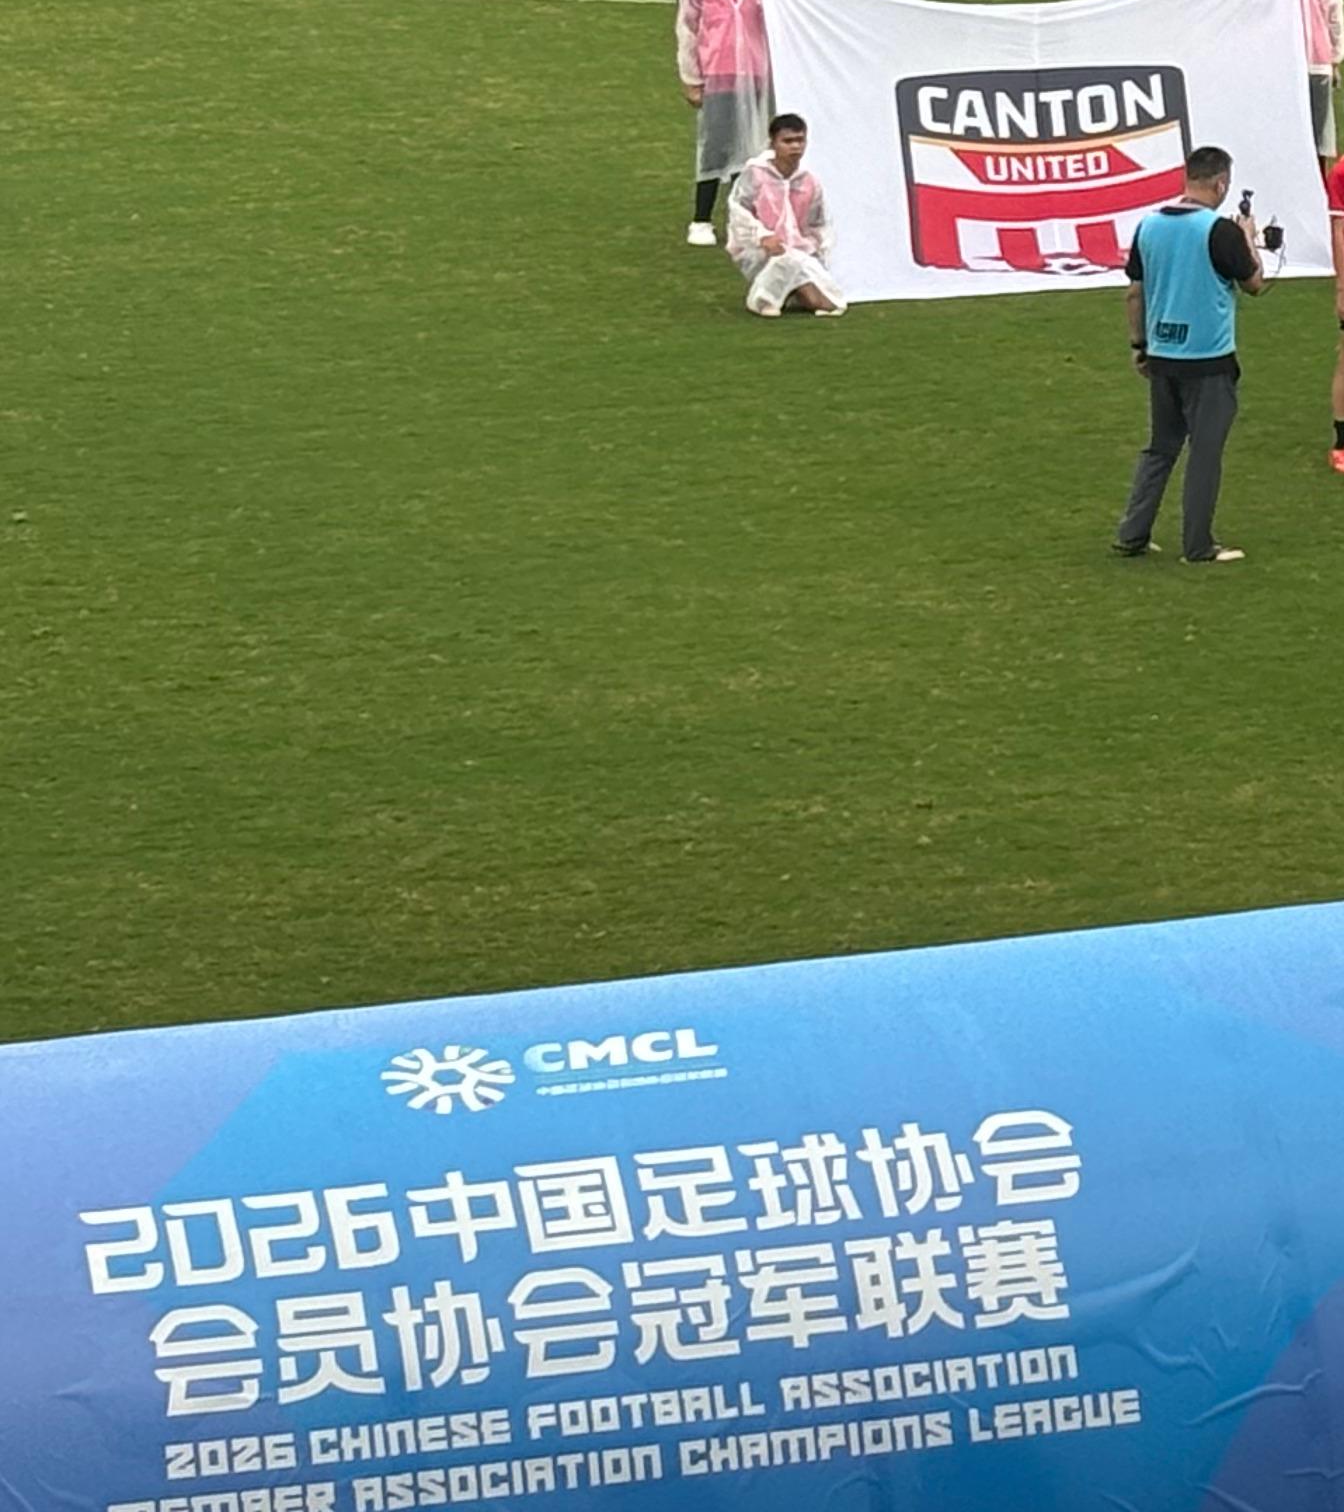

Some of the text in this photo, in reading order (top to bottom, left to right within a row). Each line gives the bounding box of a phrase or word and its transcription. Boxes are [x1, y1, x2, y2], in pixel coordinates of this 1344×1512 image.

[917, 73, 1166, 140] CANTON
[984, 149, 1110, 184] UNITED
[523, 1028, 720, 1074] CMCL
[79, 1109, 1083, 1295] 2026中国足球协会
[149, 1218, 1071, 1417] 会员协会冠军联赛
[164, 1344, 1078, 1481] 2026 CHINESE FOOTBALL ASSOCIATION
[352, 1445, 663, 1512] ASSOCIATION
[680, 1411, 954, 1477] CHAMPIONS
[969, 1389, 1142, 1444] LEAGUE
